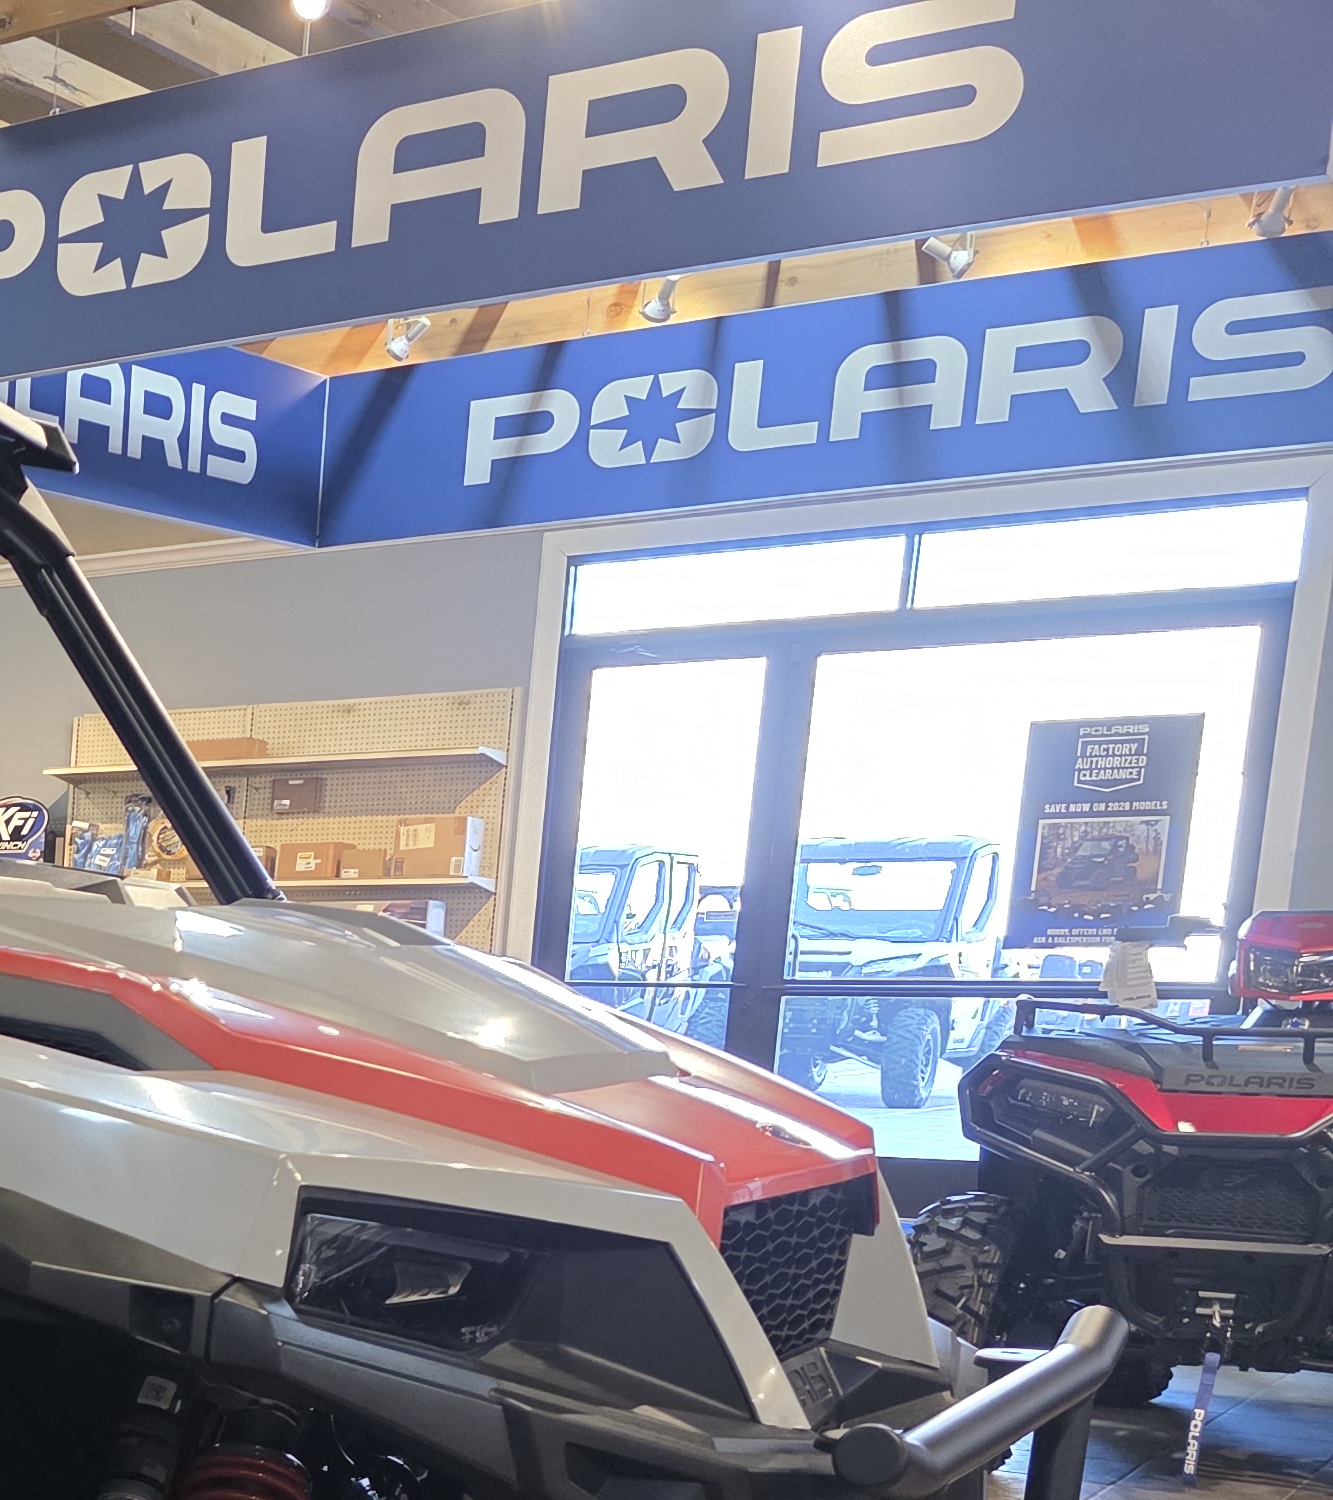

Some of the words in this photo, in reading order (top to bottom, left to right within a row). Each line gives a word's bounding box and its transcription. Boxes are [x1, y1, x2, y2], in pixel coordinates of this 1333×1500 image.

[463, 286, 1333, 487] POLARIS
[1079, 724, 1150, 735] POLARIS
[1086, 743, 1138, 756] FACTORY
[1075, 756, 1147, 769] AUTHORIZED
[1079, 768, 1139, 780] CLEARANCE
[1044, 804, 1067, 813] SAVE
[1069, 803, 1091, 812] NOW
[1093, 803, 1106, 811] ON
[1132, 801, 1168, 810] MODELS
[1184, 1073, 1315, 1090] POLARIS
[1184, 1408, 1205, 1475] POLARIS
